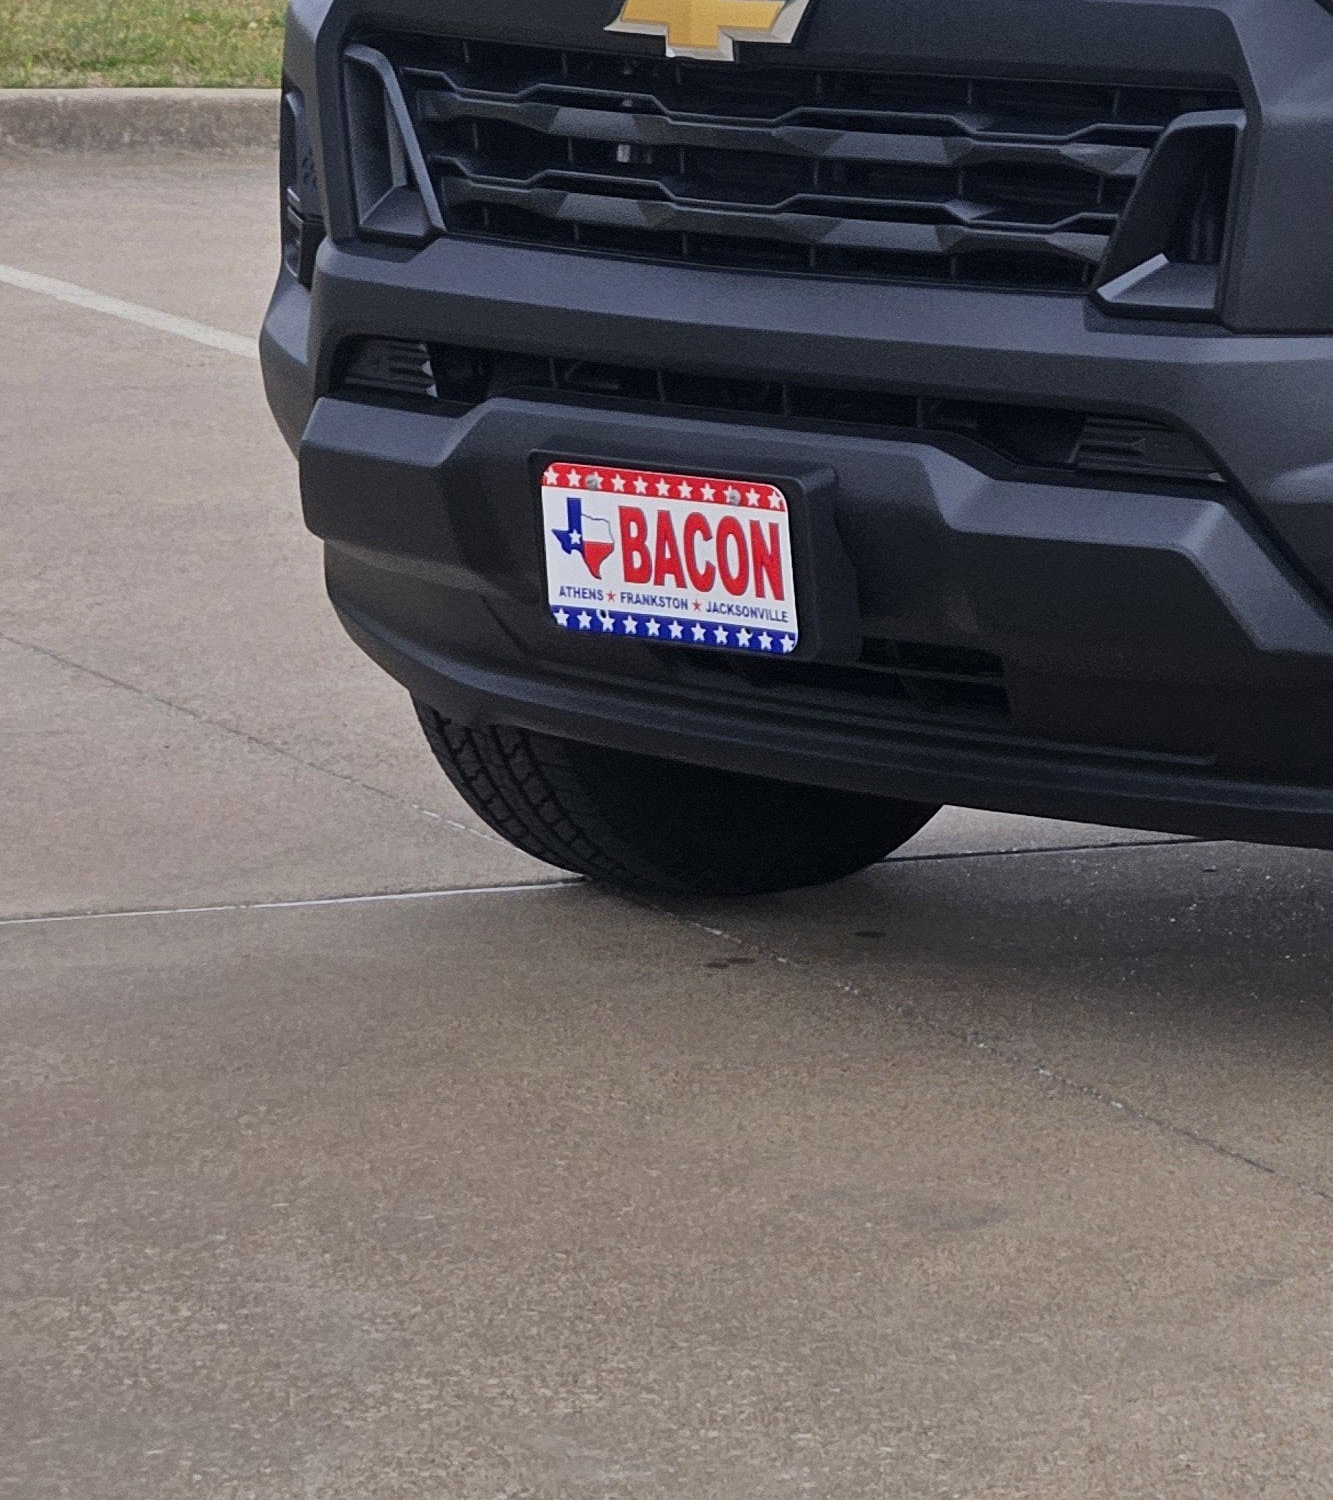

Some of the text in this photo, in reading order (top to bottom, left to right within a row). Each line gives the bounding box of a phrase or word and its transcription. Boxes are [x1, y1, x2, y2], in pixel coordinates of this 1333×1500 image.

[618, 505, 785, 601] BACON
[558, 585, 789, 623] ATHENS FRANKSTON JACKSONVILLE
